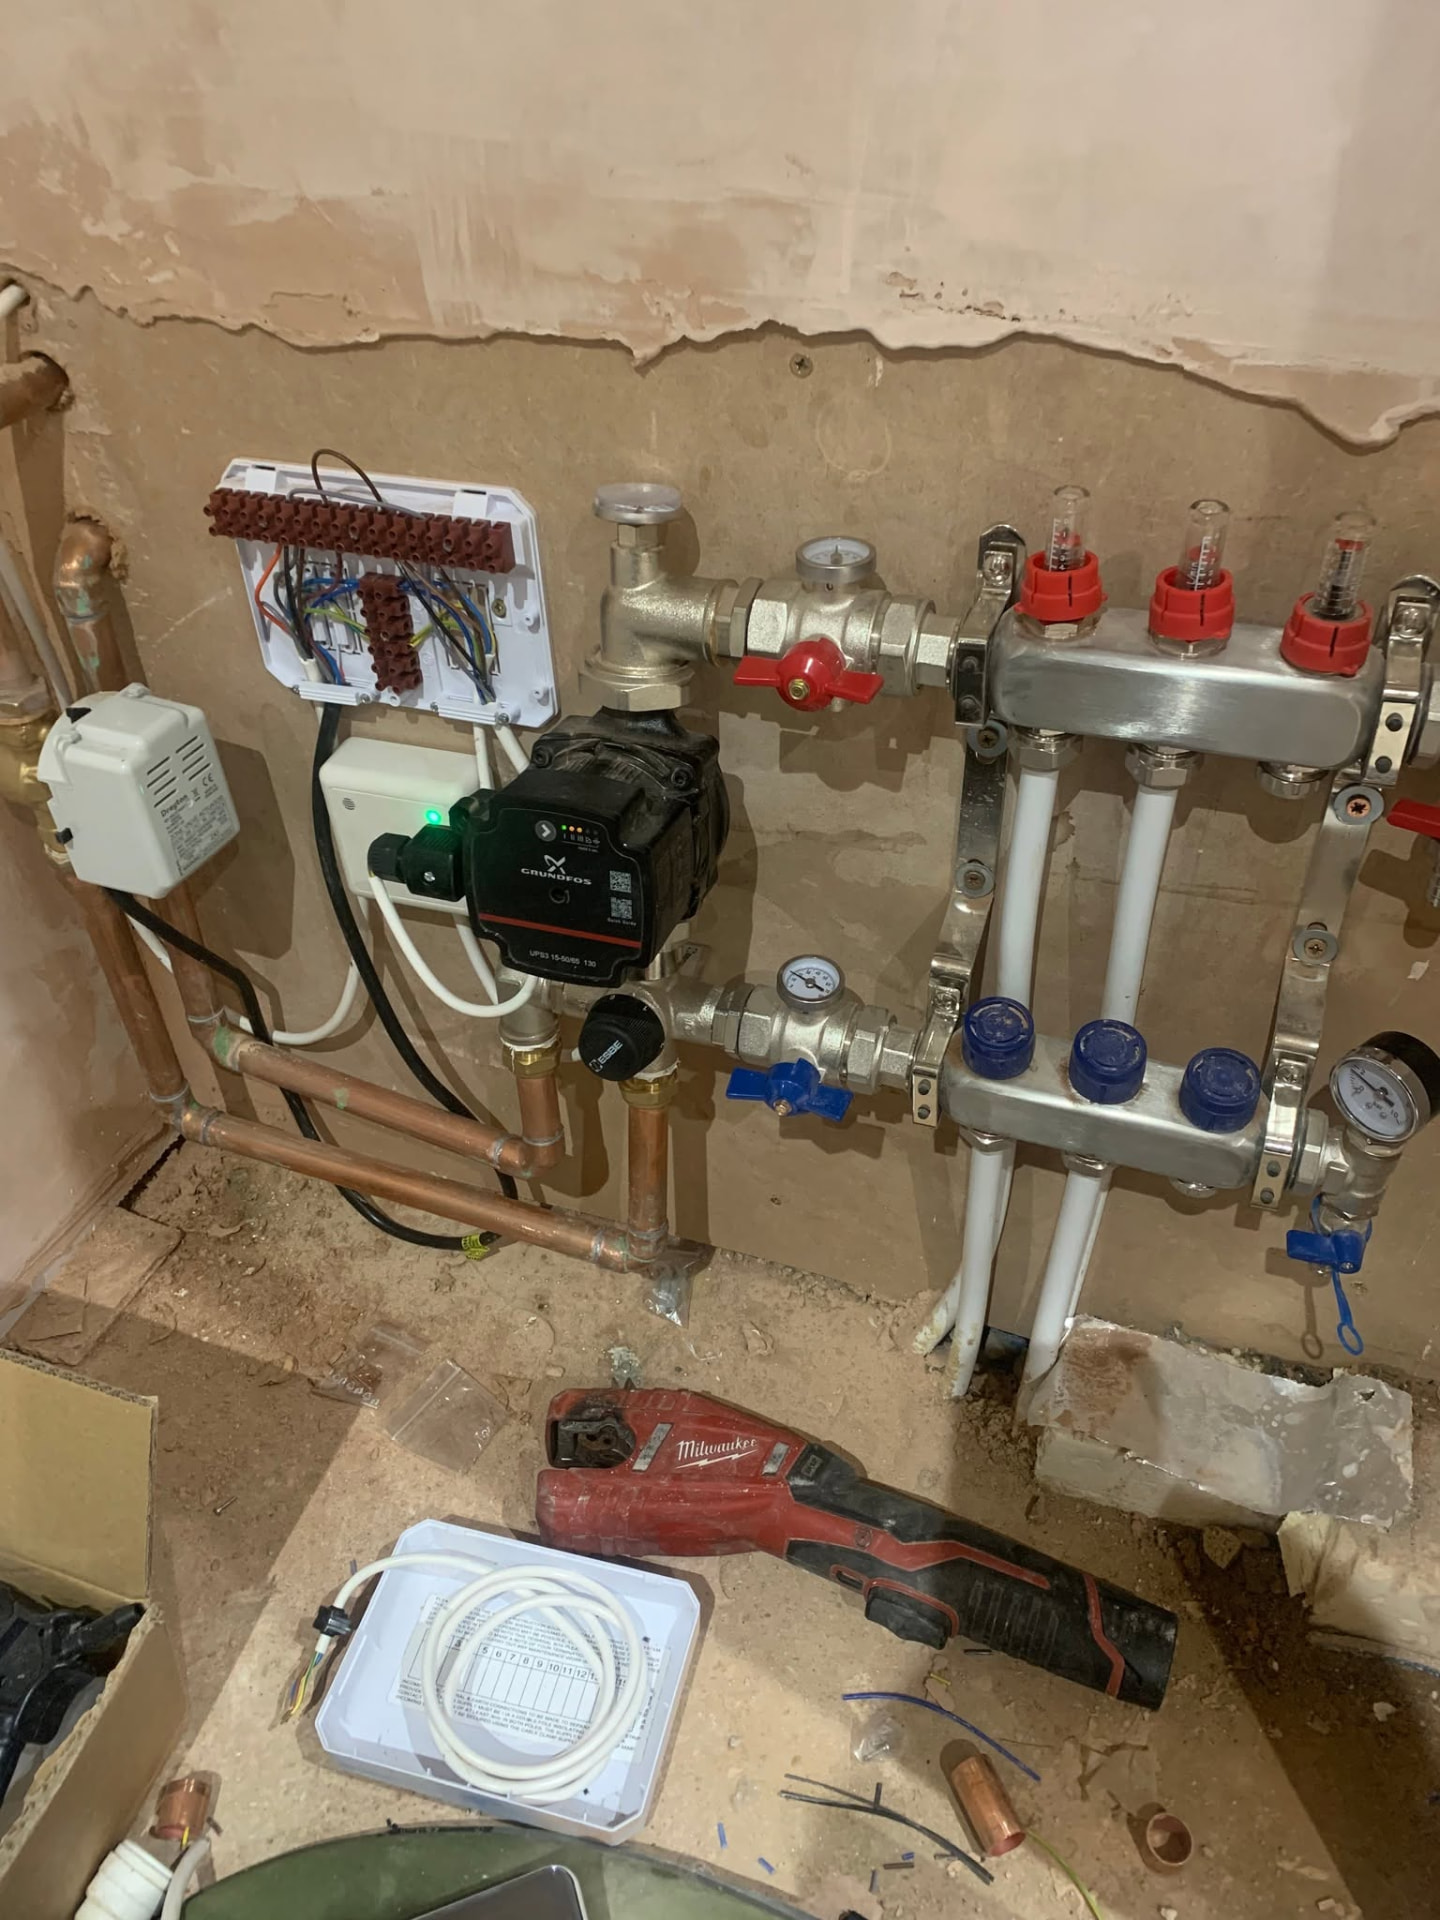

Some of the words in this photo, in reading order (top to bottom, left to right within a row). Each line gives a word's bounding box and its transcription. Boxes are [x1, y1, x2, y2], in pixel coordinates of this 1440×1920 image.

[521, 868, 592, 885] GRUNDFOS
[529, 950, 549, 960] UPS3
[598, 1040, 623, 1064] ESBE
[677, 1437, 758, 1461] Milwaukee
[481, 1646, 489, 1655] 5
[495, 1650, 502, 1658] 6
[509, 1653, 517, 1661] 7
[522, 1657, 530, 1665] 8
[536, 1660, 544, 1668] 9
[548, 1663, 560, 1672] 10
[562, 1666, 574, 1675] 11
[576, 1669, 588, 1678] 12
